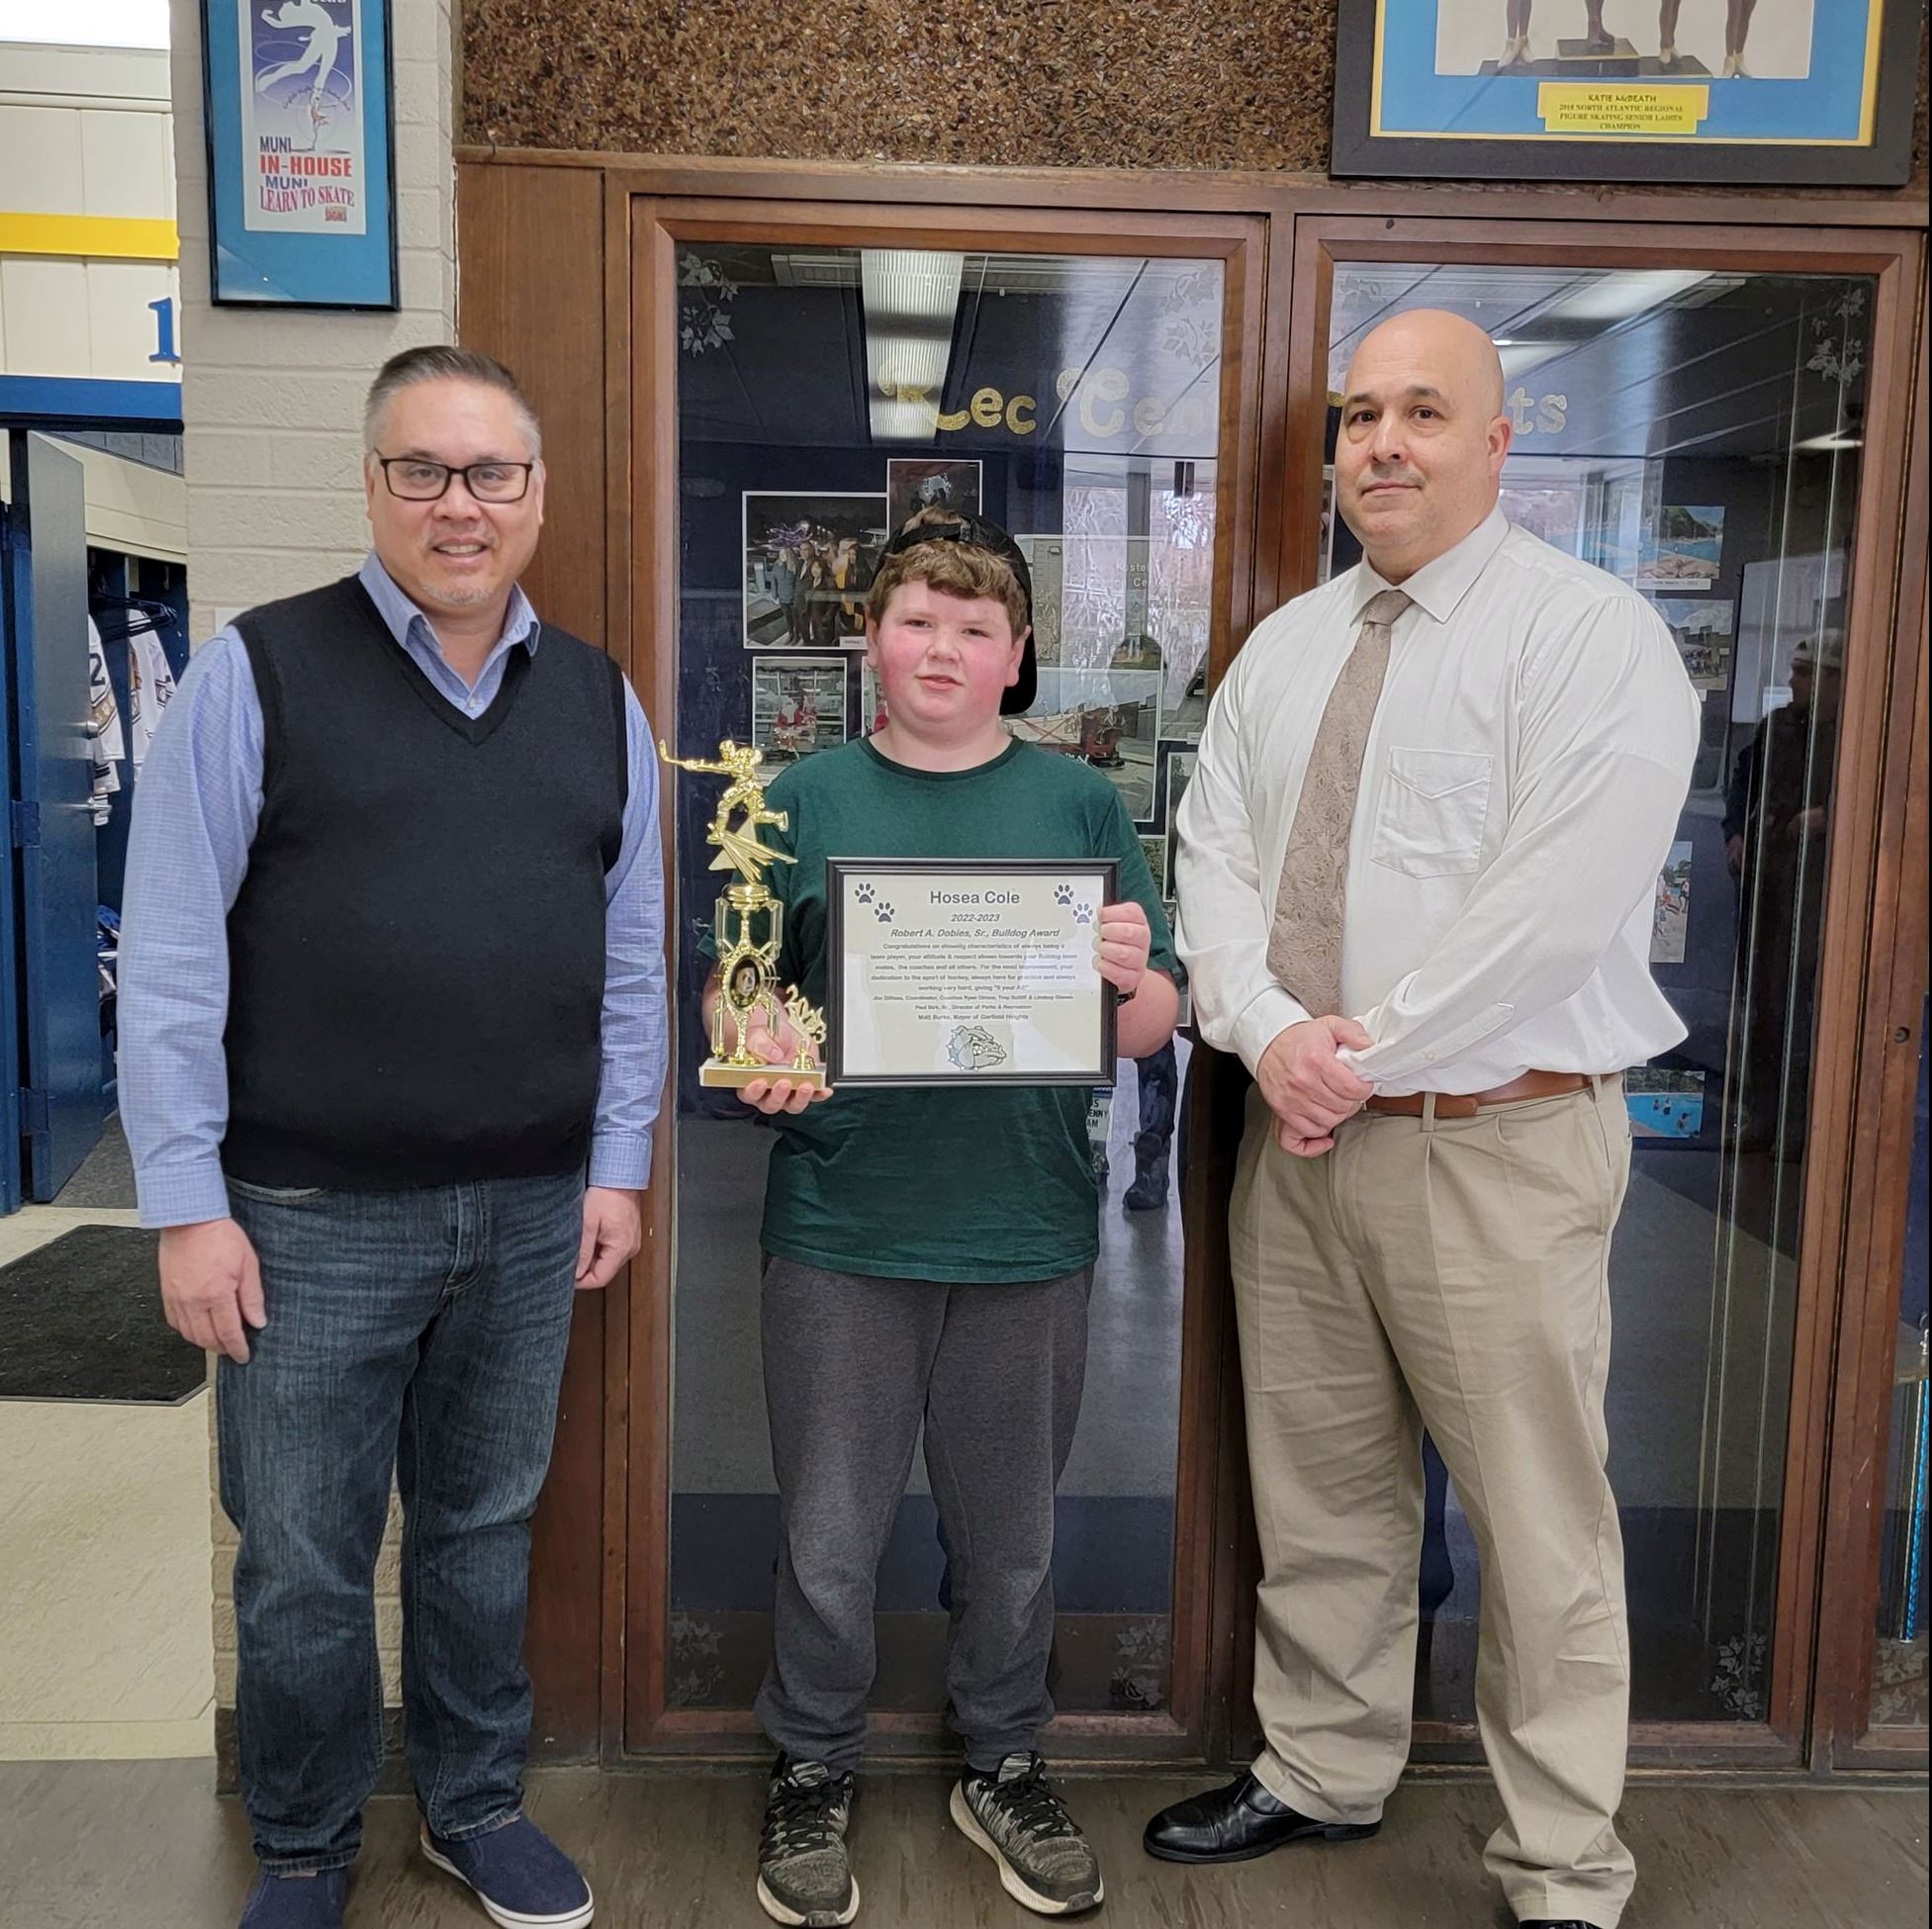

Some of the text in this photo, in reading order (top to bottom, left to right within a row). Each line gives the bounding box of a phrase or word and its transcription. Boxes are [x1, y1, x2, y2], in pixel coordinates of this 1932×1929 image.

[259, 136, 292, 153] MUNI
[260, 154, 352, 177] IN-HOUSE
[265, 175, 308, 190] MUNI
[259, 185, 354, 213] LEARN TO SKATE
[930, 890, 1020, 905] Hosea Cole
[951, 913, 1000, 923] 2022-2023
[890, 928, 924, 939] Robert
[925, 928, 935, 938] A.
[974, 928, 989, 939] Sr.,
[992, 928, 1028, 939] Bulldog
[1030, 928, 1060, 938] Award
